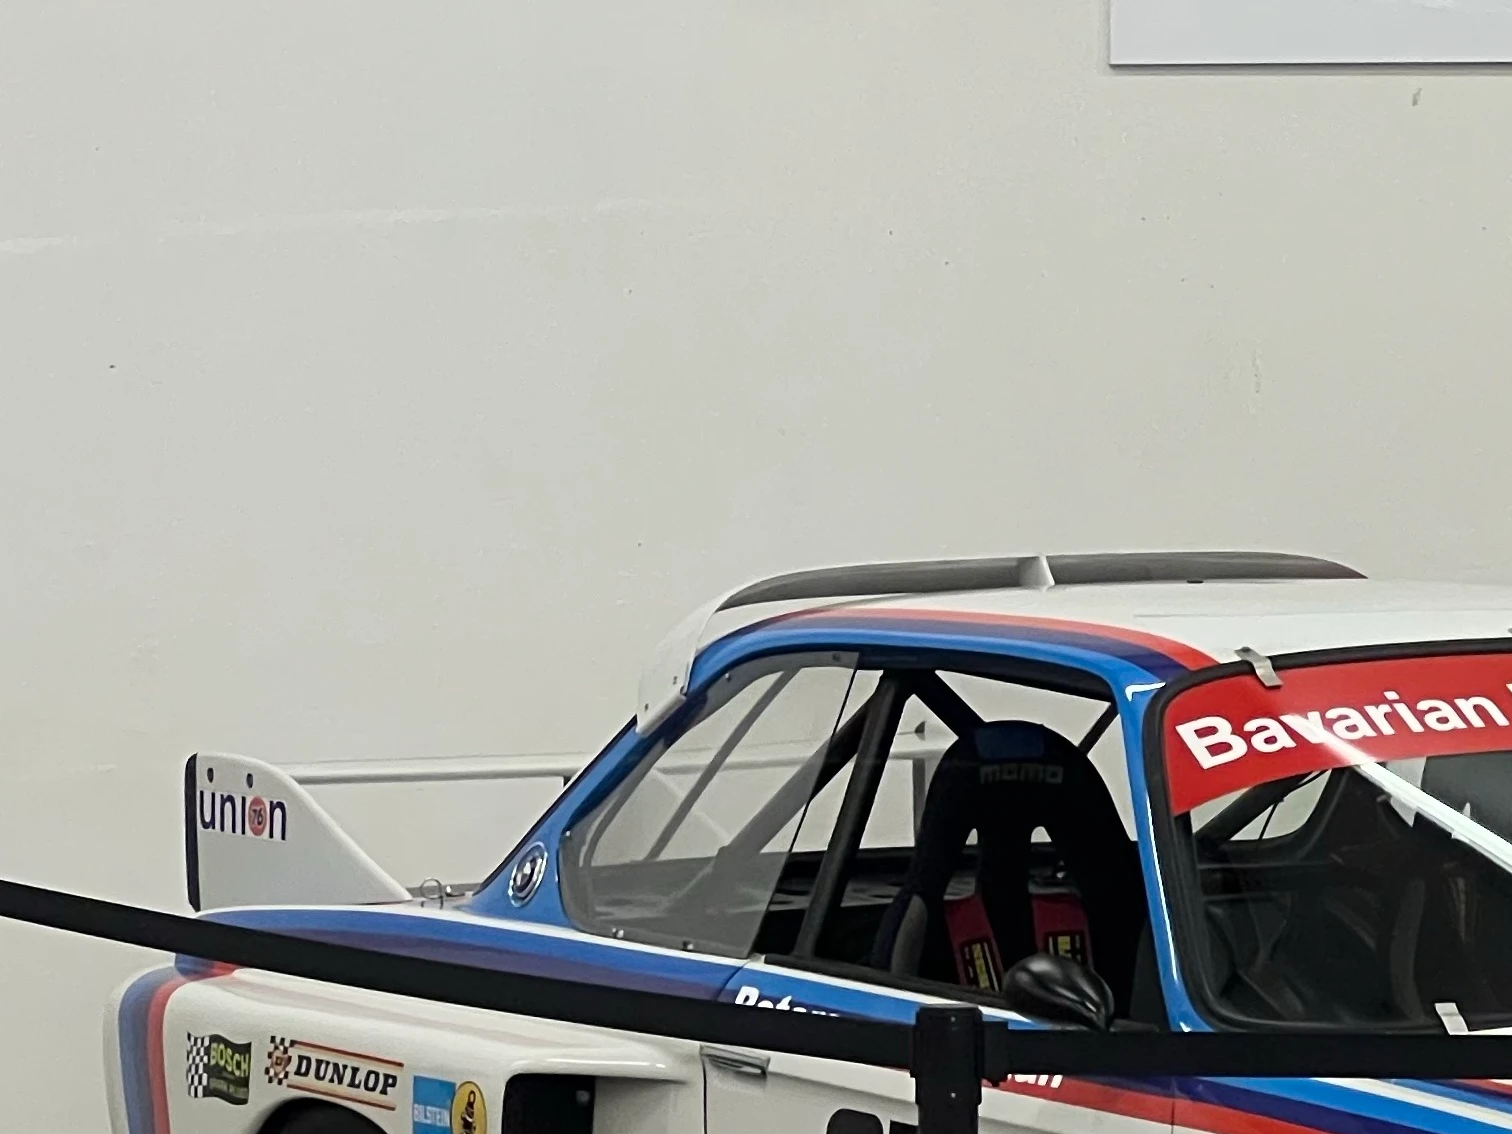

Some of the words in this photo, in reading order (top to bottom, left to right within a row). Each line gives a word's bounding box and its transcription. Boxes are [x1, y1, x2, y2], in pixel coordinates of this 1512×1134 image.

[1175, 691, 1510, 770] Bavarian
[210, 1042, 250, 1077] BOSCH
[294, 1054, 398, 1096] DUNLOP
[412, 1103, 451, 1128] BILSTEIN
